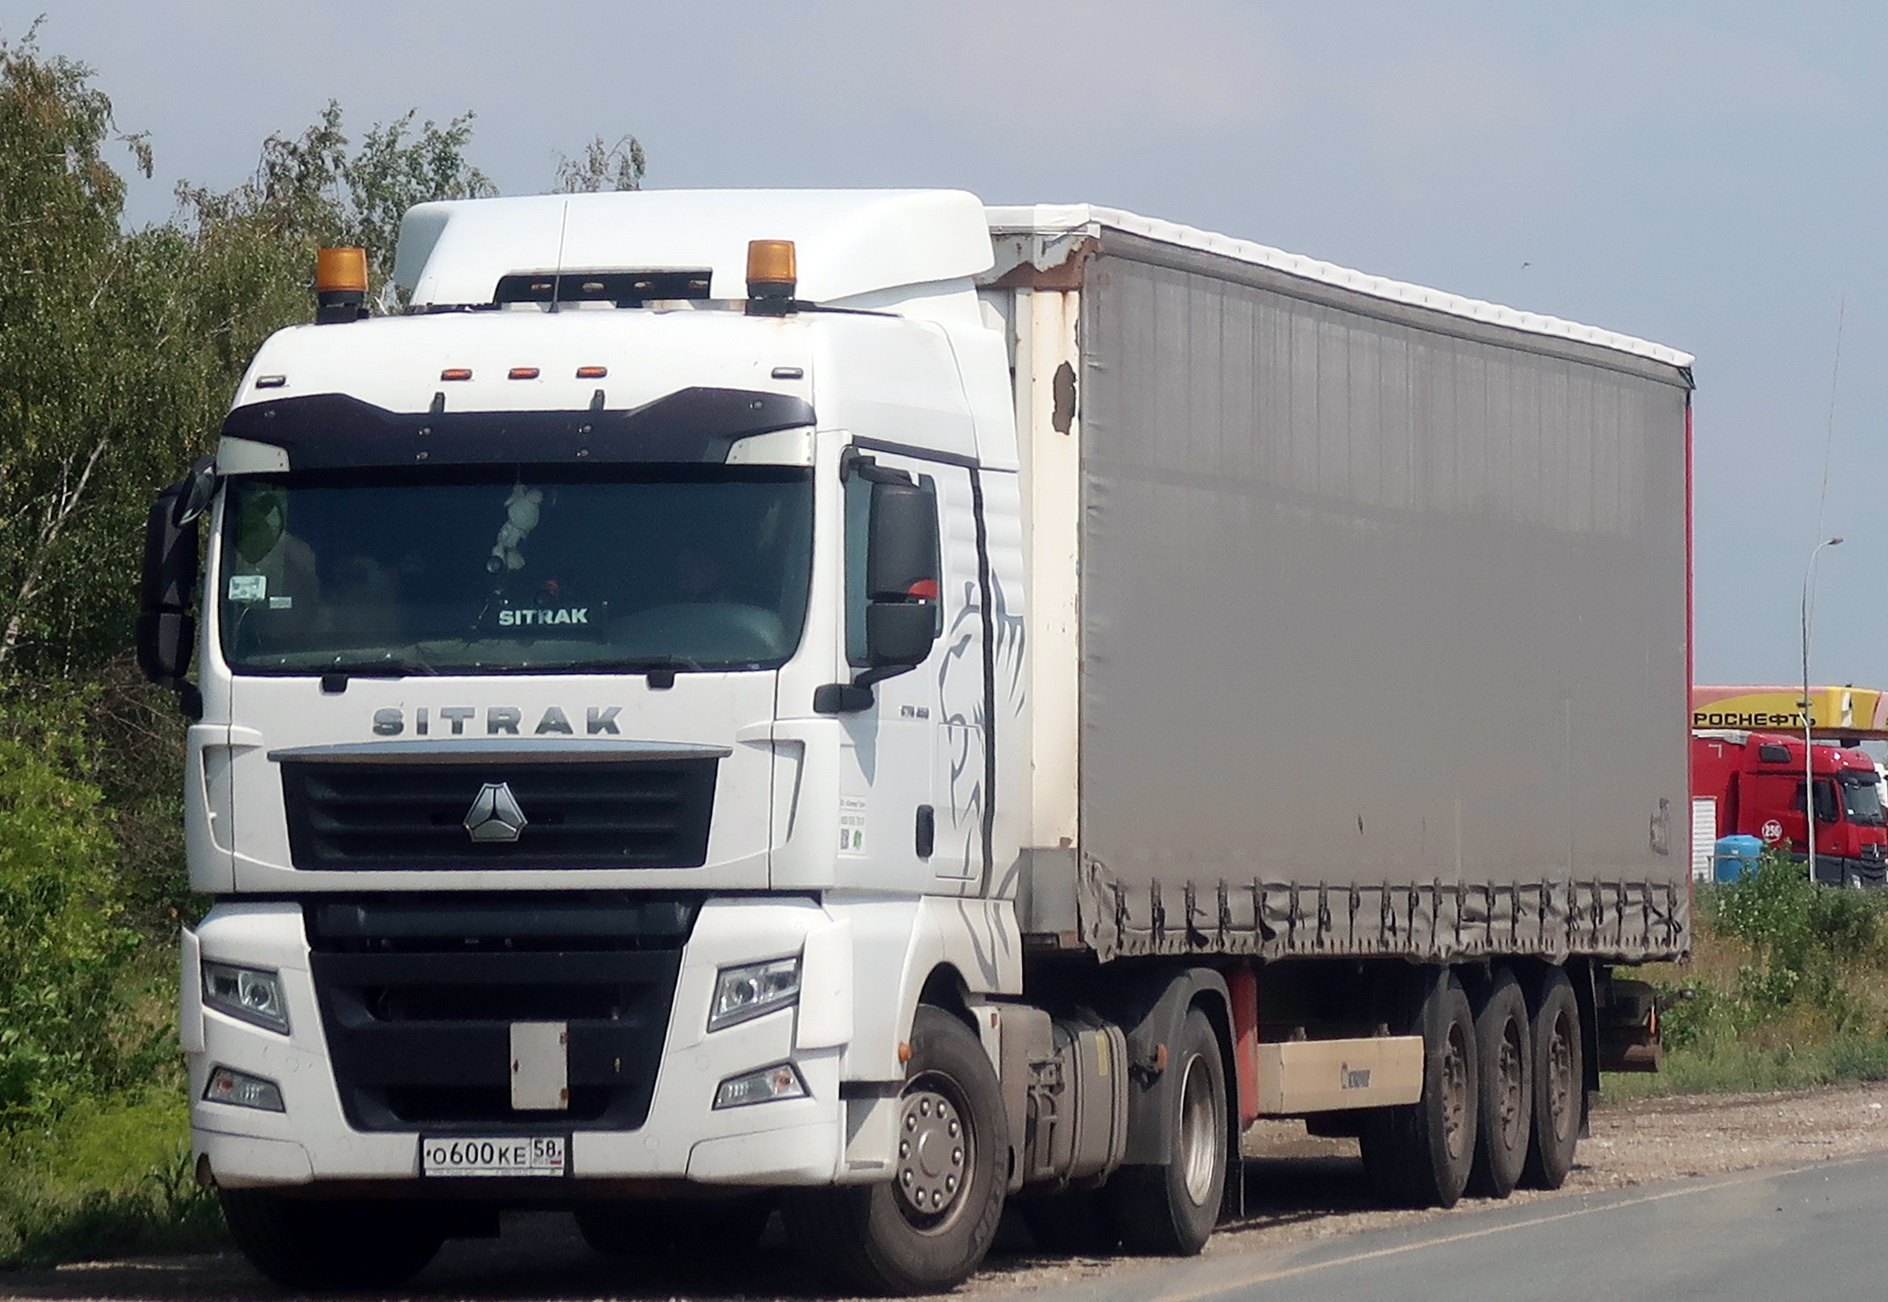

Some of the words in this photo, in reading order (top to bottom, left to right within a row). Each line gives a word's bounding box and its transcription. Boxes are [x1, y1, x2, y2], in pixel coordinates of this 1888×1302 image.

[499, 608, 588, 626] SITRAK
[373, 706, 623, 735] SITRAK
[534, 1140, 556, 1158] 58
